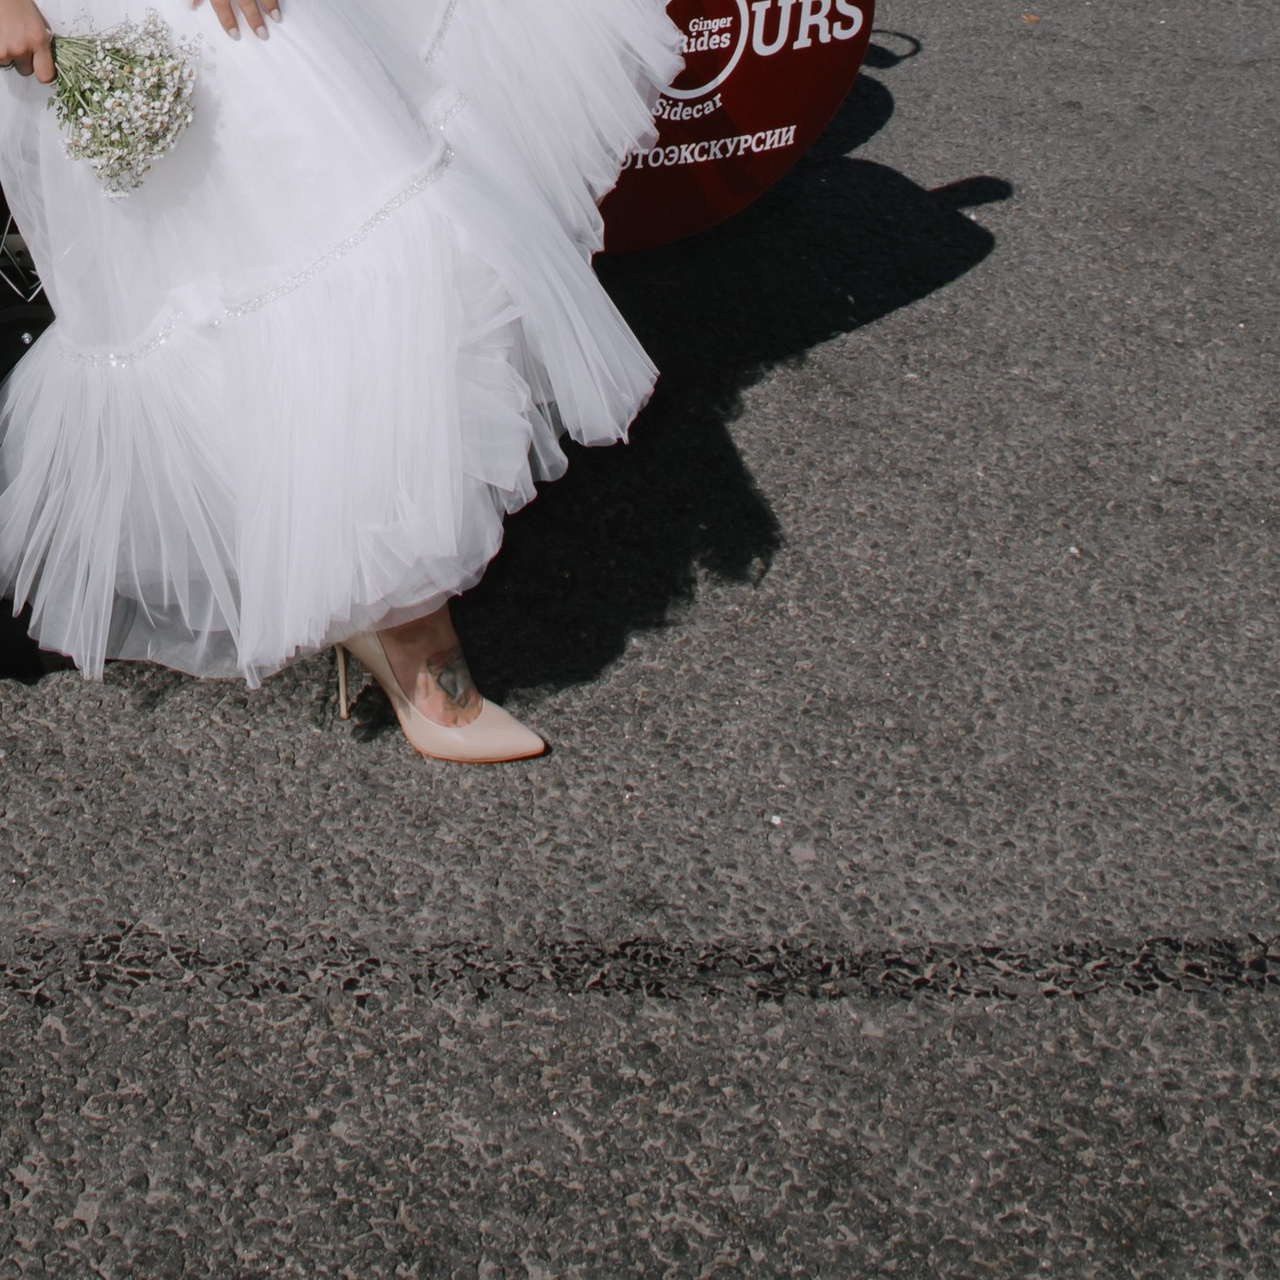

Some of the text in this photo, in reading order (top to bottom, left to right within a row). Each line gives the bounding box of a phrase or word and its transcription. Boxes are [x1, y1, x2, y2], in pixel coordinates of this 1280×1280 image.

[688, 16, 733, 33] Ginger
[651, 93, 723, 121] Sidecar
[620, 125, 797, 171] ОТОЭКСКУРСИИ
